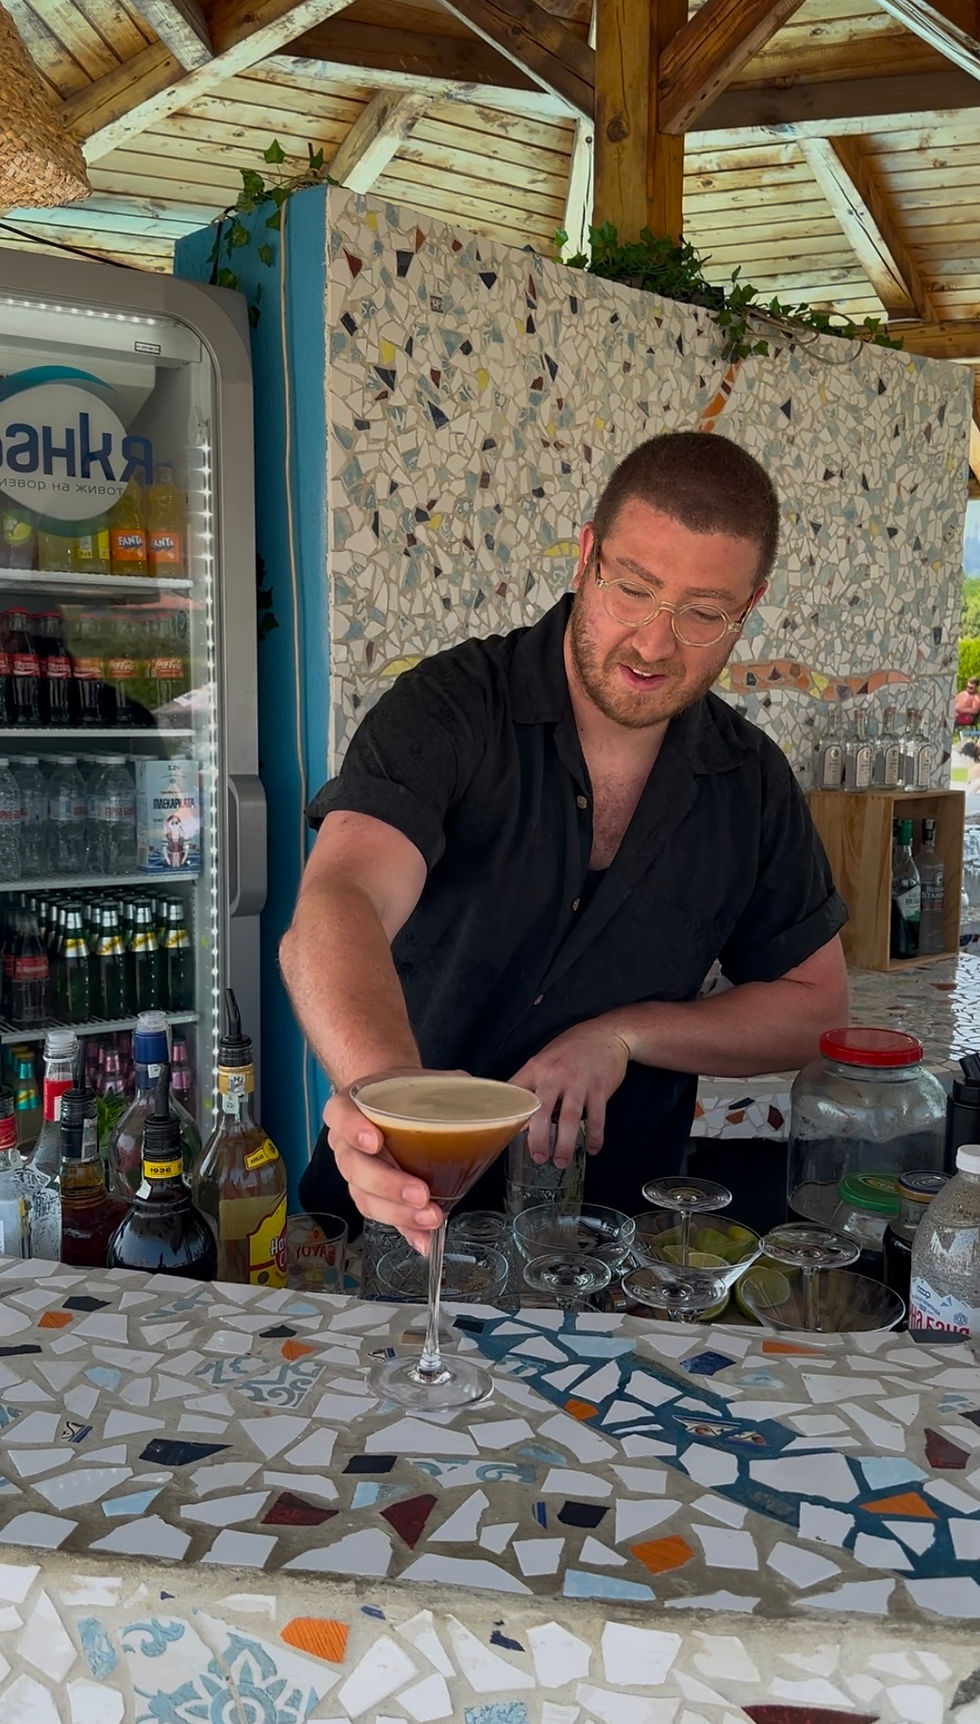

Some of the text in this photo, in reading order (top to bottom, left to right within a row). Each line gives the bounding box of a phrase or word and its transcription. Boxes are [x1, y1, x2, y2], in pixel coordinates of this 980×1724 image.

[0, 411, 154, 486] анкя
[52, 482, 69, 491] на
[76, 484, 123, 496] живот
